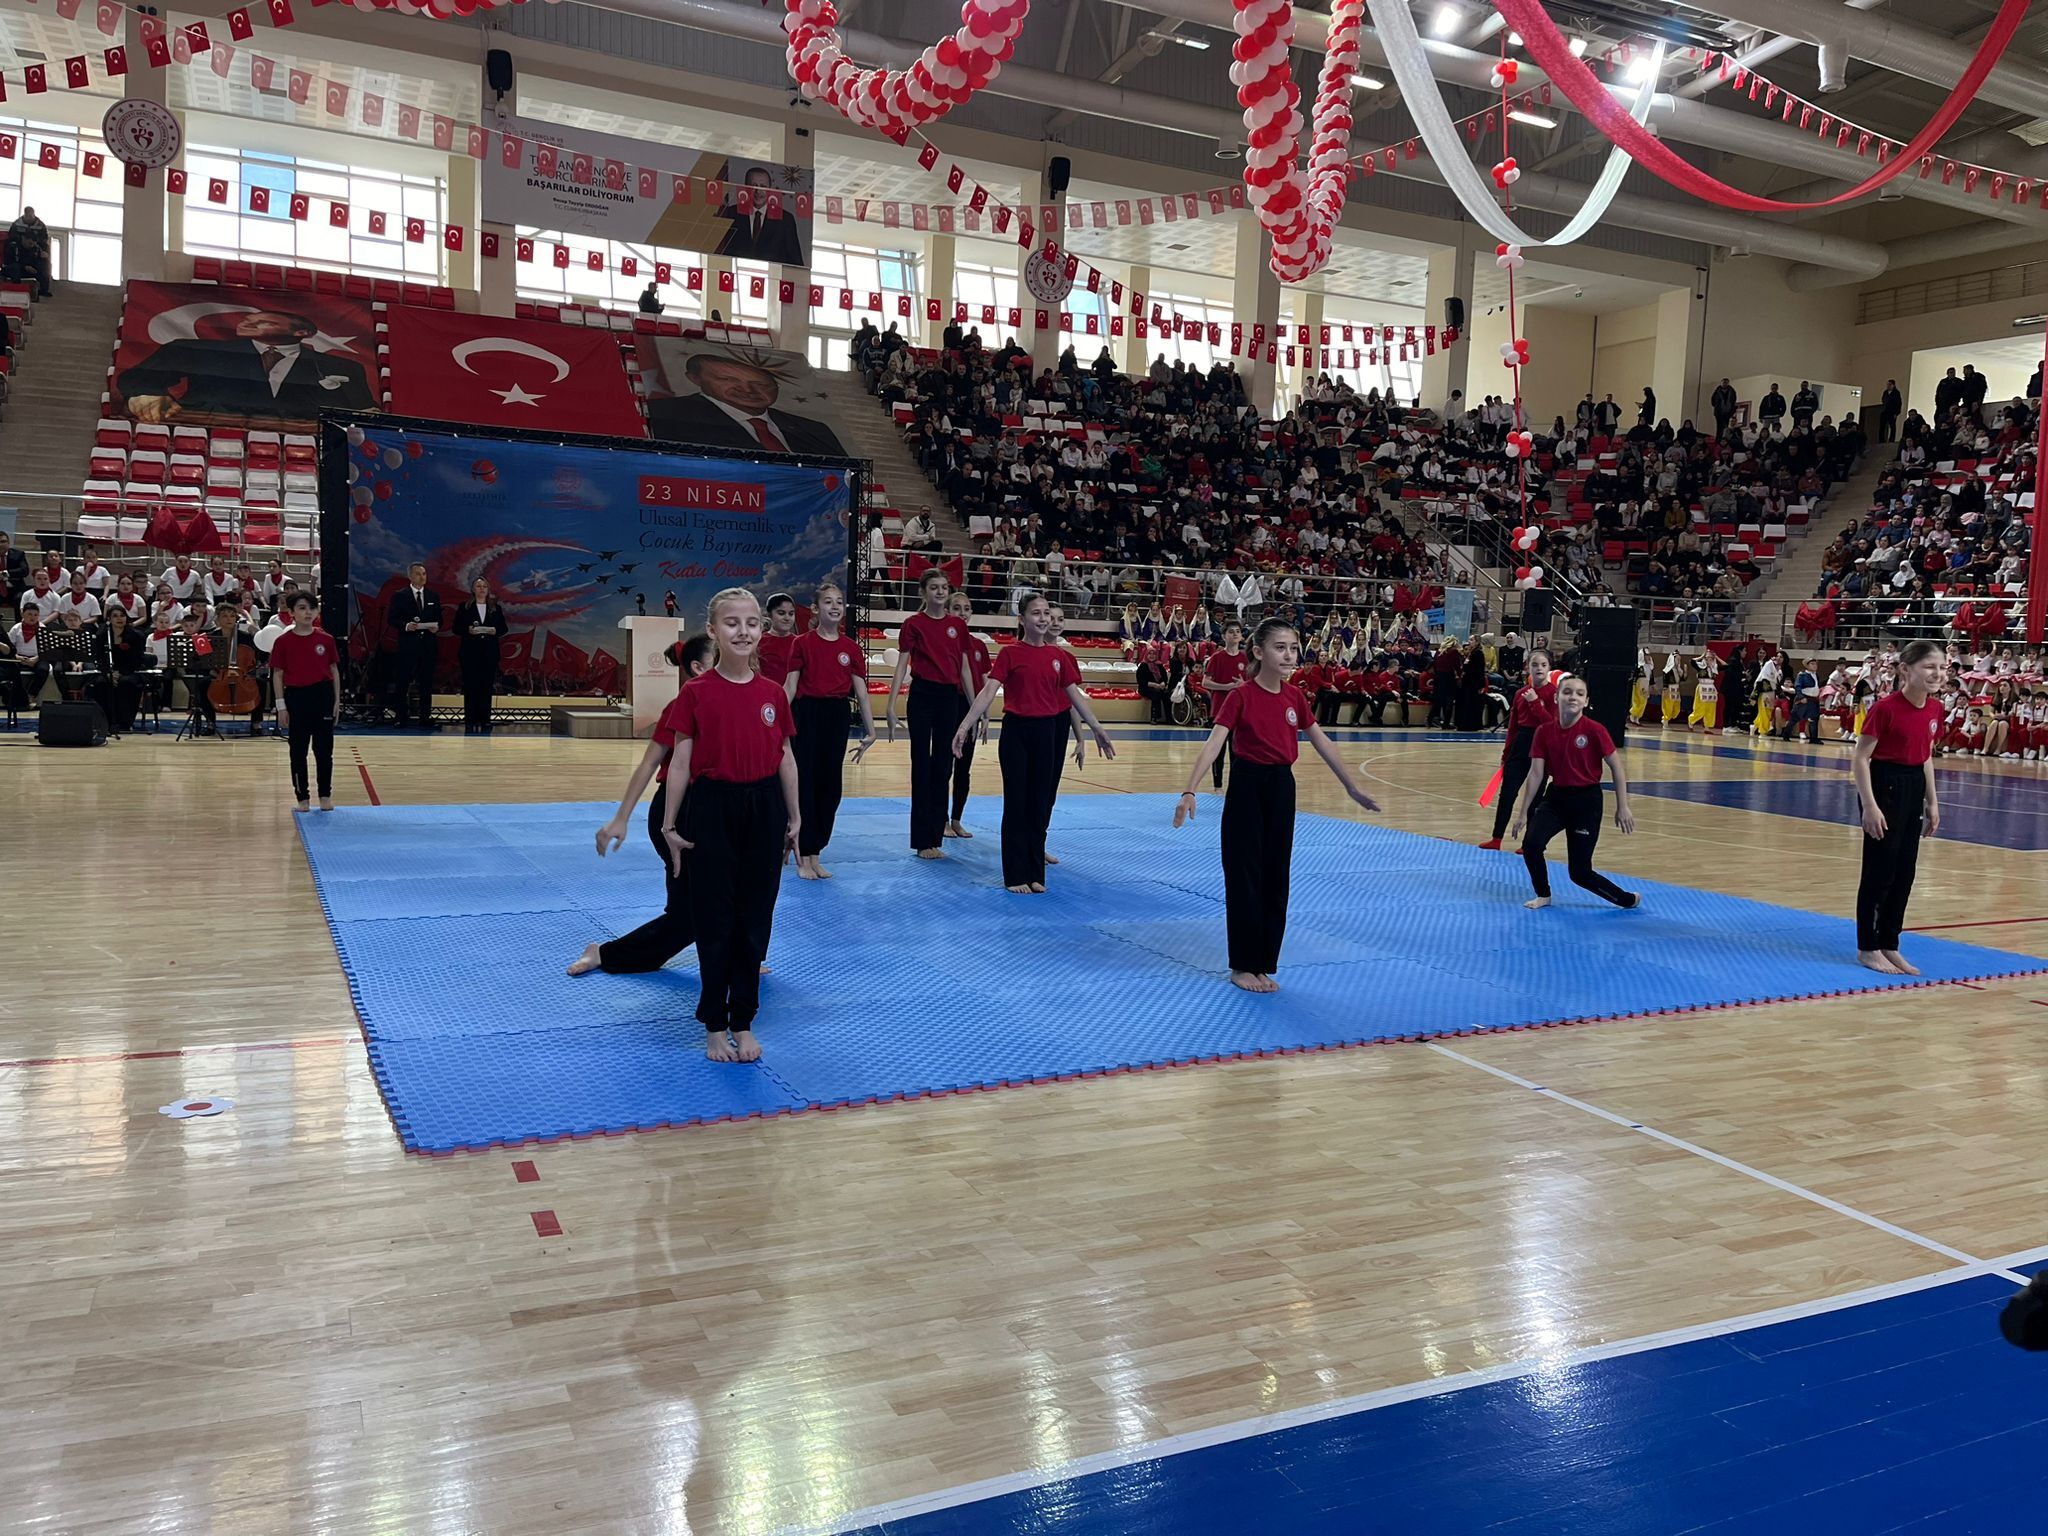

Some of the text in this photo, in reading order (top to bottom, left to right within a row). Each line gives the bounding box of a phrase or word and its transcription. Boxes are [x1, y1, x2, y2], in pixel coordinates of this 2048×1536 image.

[527, 178, 634, 204] BAŞARILAR DİLİYORUM
[644, 483, 761, 507] 23 NİSAN
[638, 509, 796, 535] Ulusal Egemenlik ve
[638, 530, 774, 557] Çocuk Bayramı
[658, 559, 760, 580] Kutlu Olsun
